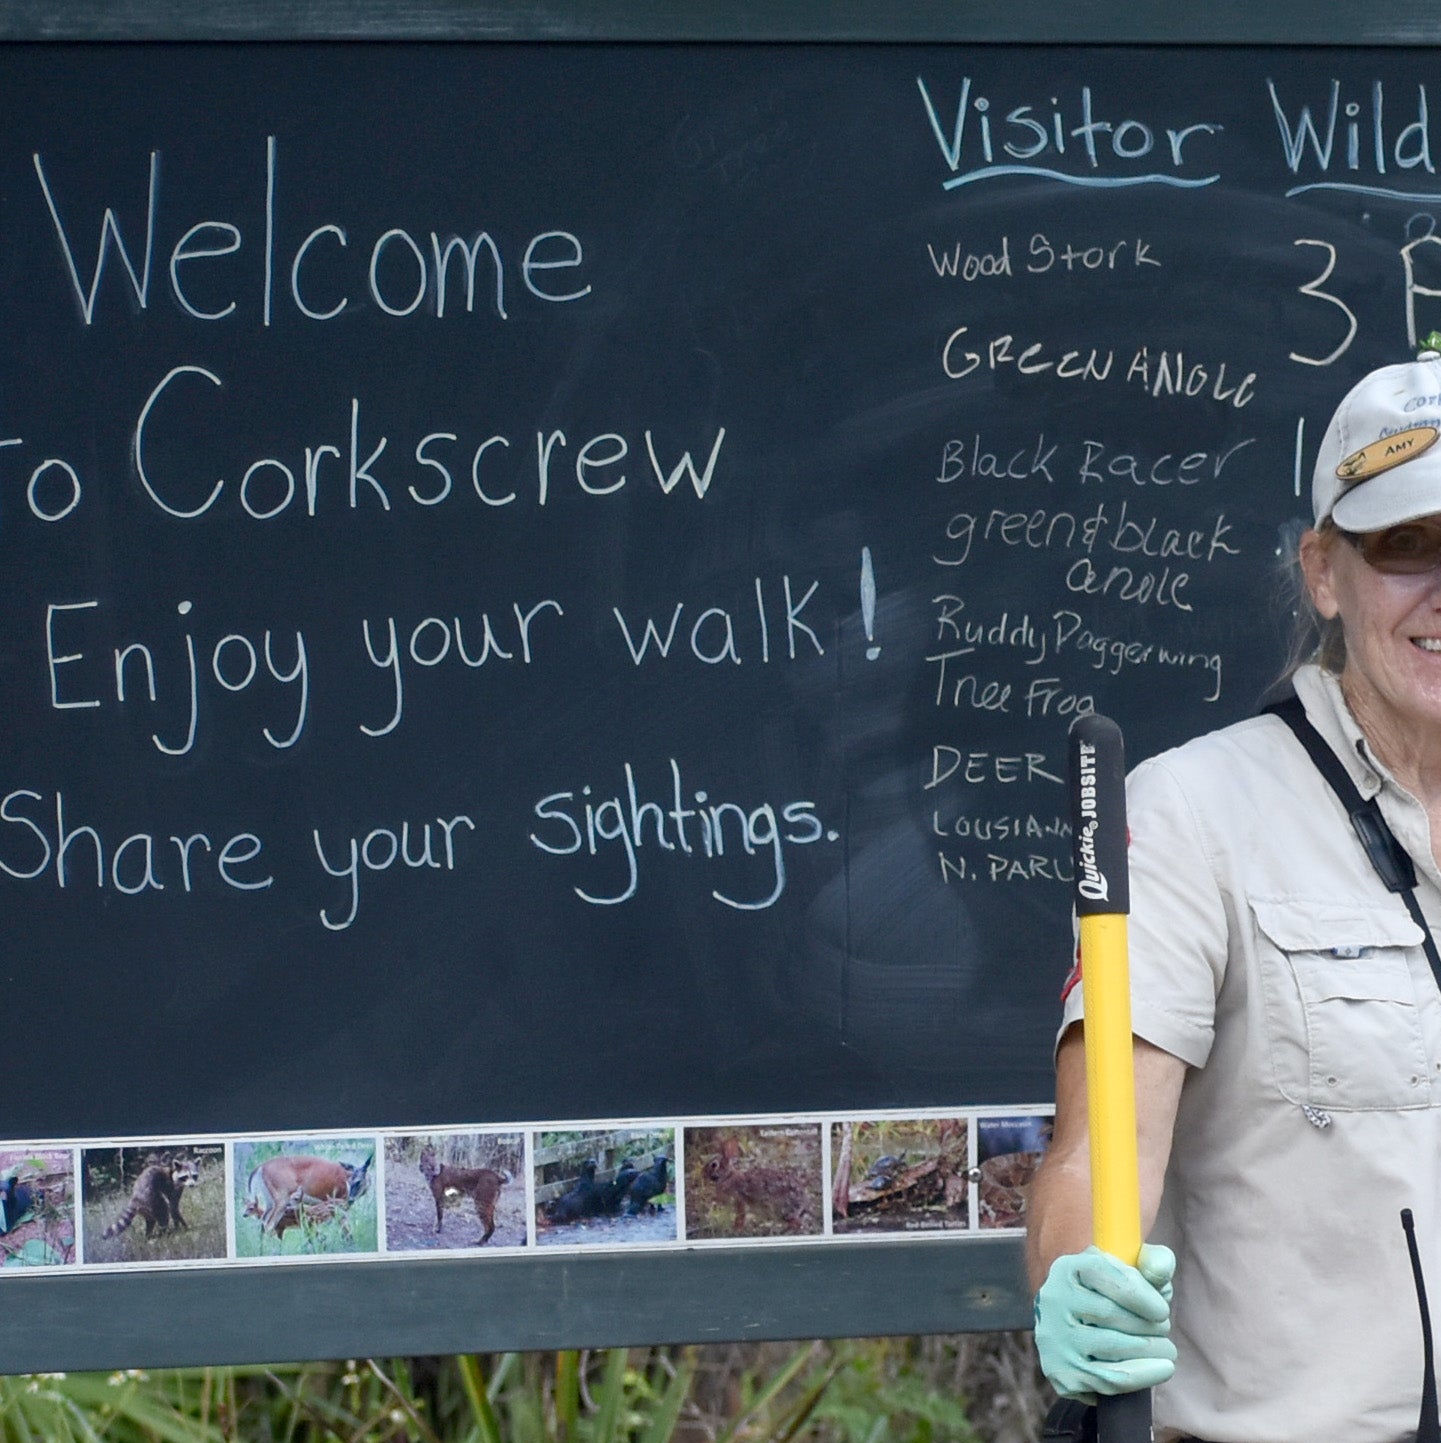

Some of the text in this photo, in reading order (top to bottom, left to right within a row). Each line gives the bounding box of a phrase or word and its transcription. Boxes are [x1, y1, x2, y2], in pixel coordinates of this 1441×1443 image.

[916, 76, 1224, 172] Visitor
[33, 135, 592, 326] Welcome
[927, 233, 1162, 282] Wood Stork
[1288, 238, 1358, 367] 3
[0, 365, 726, 521] o Corkscrew
[935, 434, 1258, 486] Black Racer
[1384, 437, 1416, 458] AMY
[932, 594, 1049, 666] Ruddy
[47, 600, 309, 755] Enjoy
[360, 599, 564, 737] your
[923, 744, 1066, 790] DEER
[1080, 741, 1098, 819] JOBSITE
[0, 789, 274, 895] Share
[313, 814, 476, 930] your
